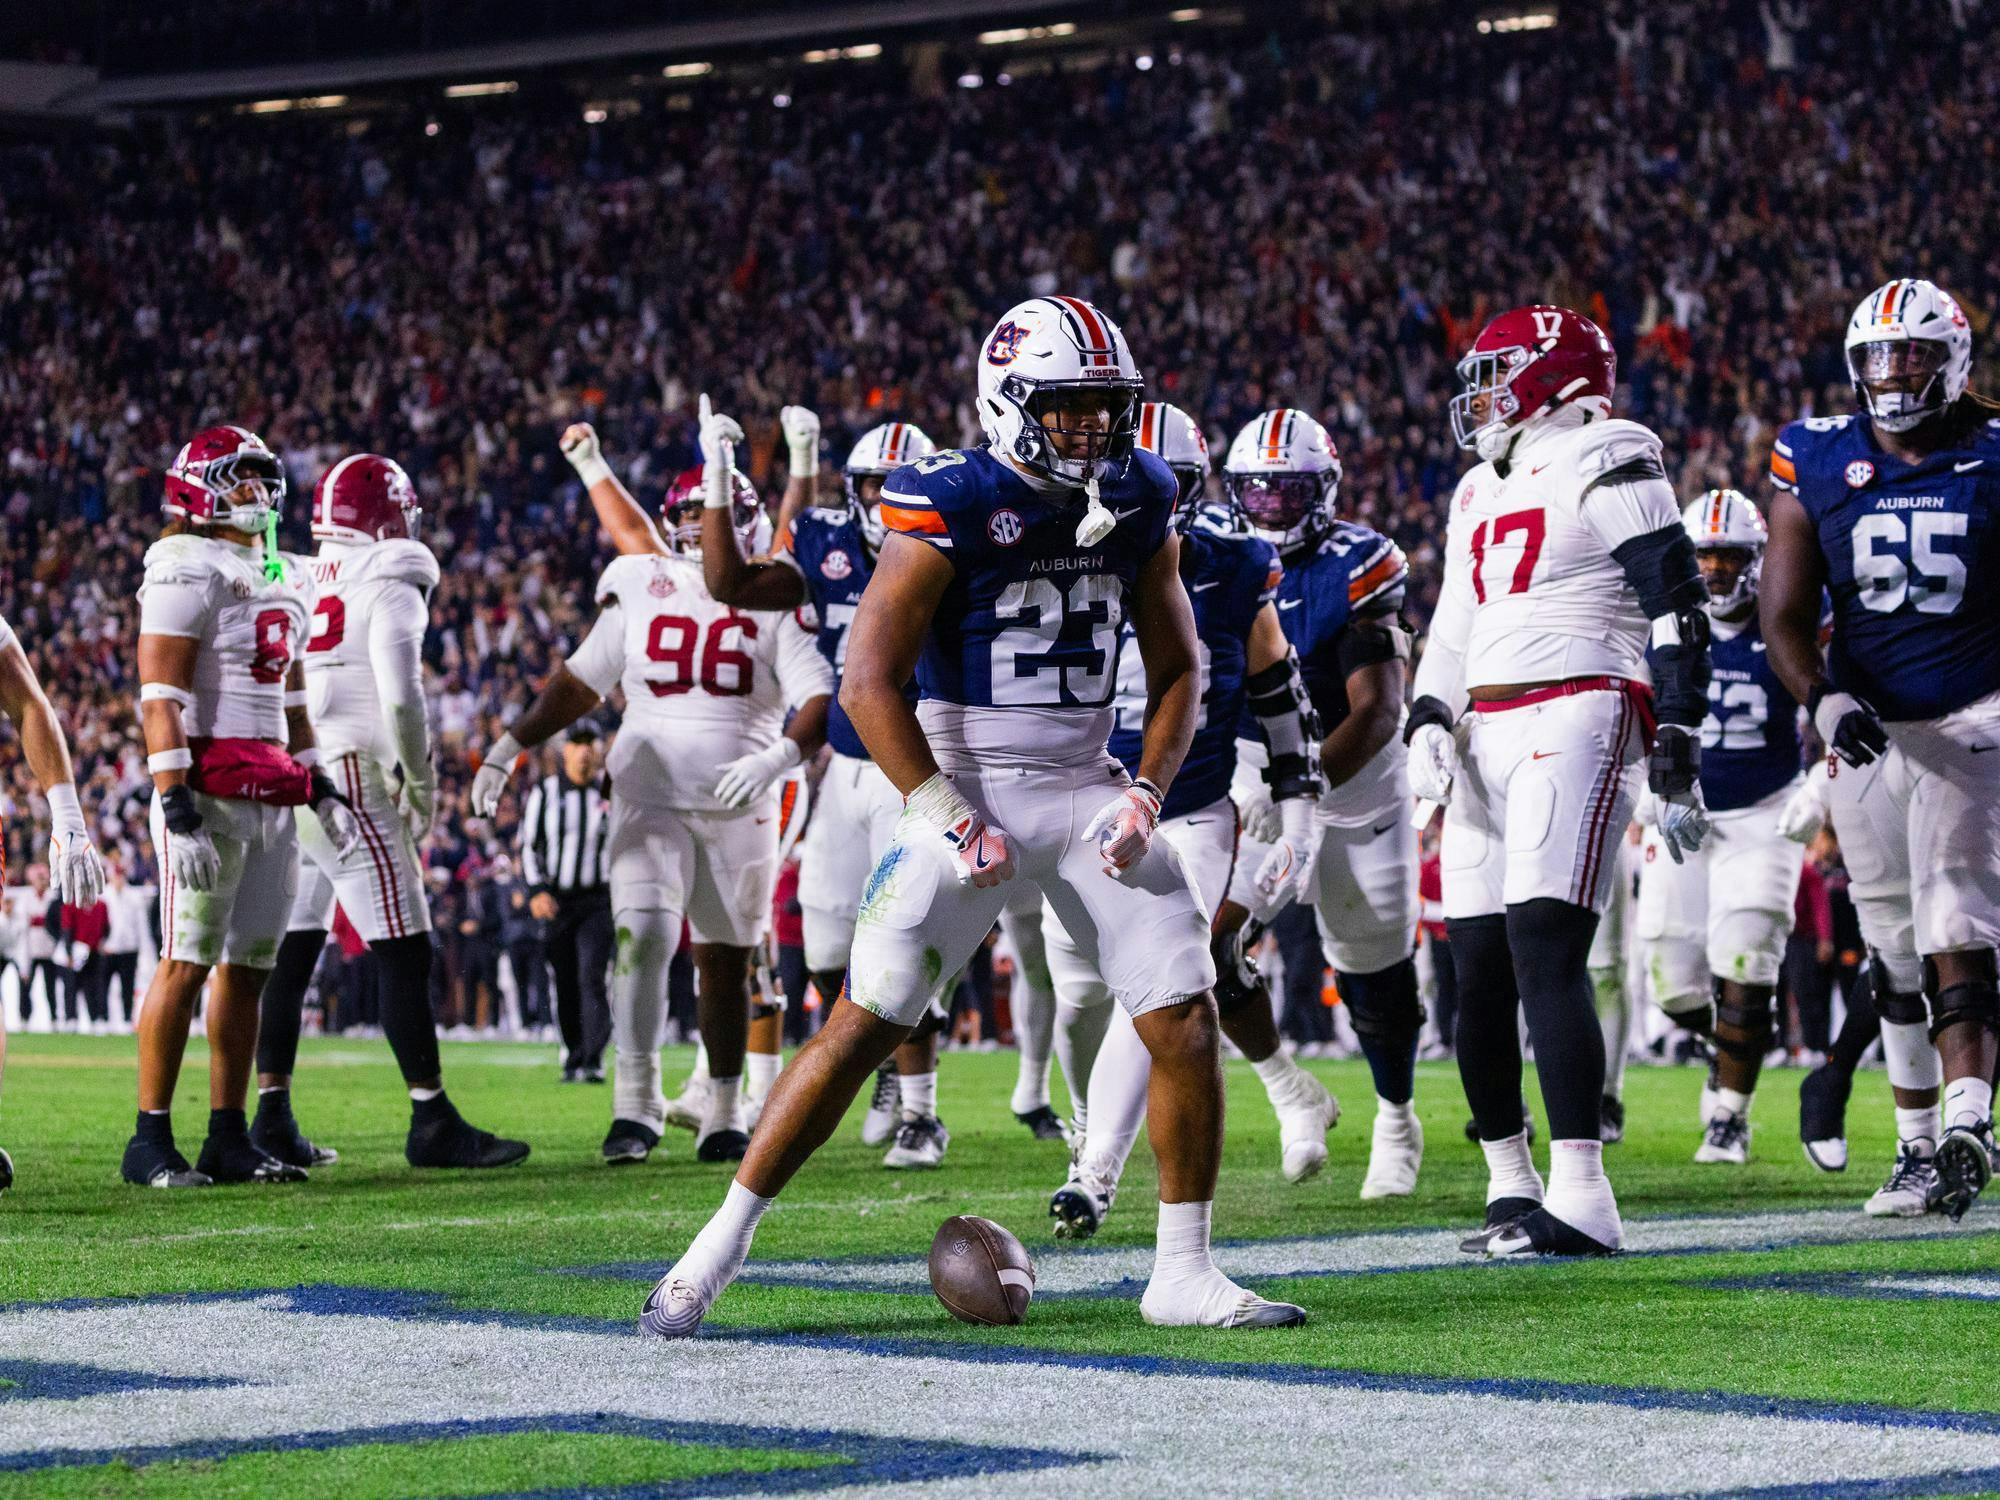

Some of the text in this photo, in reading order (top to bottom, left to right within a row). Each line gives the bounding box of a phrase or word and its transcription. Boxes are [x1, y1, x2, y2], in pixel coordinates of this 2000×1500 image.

[1531, 312, 1563, 338] 17
[1085, 369, 1120, 377] TIGERS
[1847, 461, 1873, 487] SEC
[1875, 496, 1945, 510] AUBURN
[990, 510, 1022, 545] SEC
[1029, 556, 1104, 573] AUBURN
[1471, 507, 1546, 605] 17
[1852, 512, 1969, 615] 65
[249, 609, 290, 685] 8
[645, 611, 759, 698] 96
[991, 574, 1124, 705] 23
